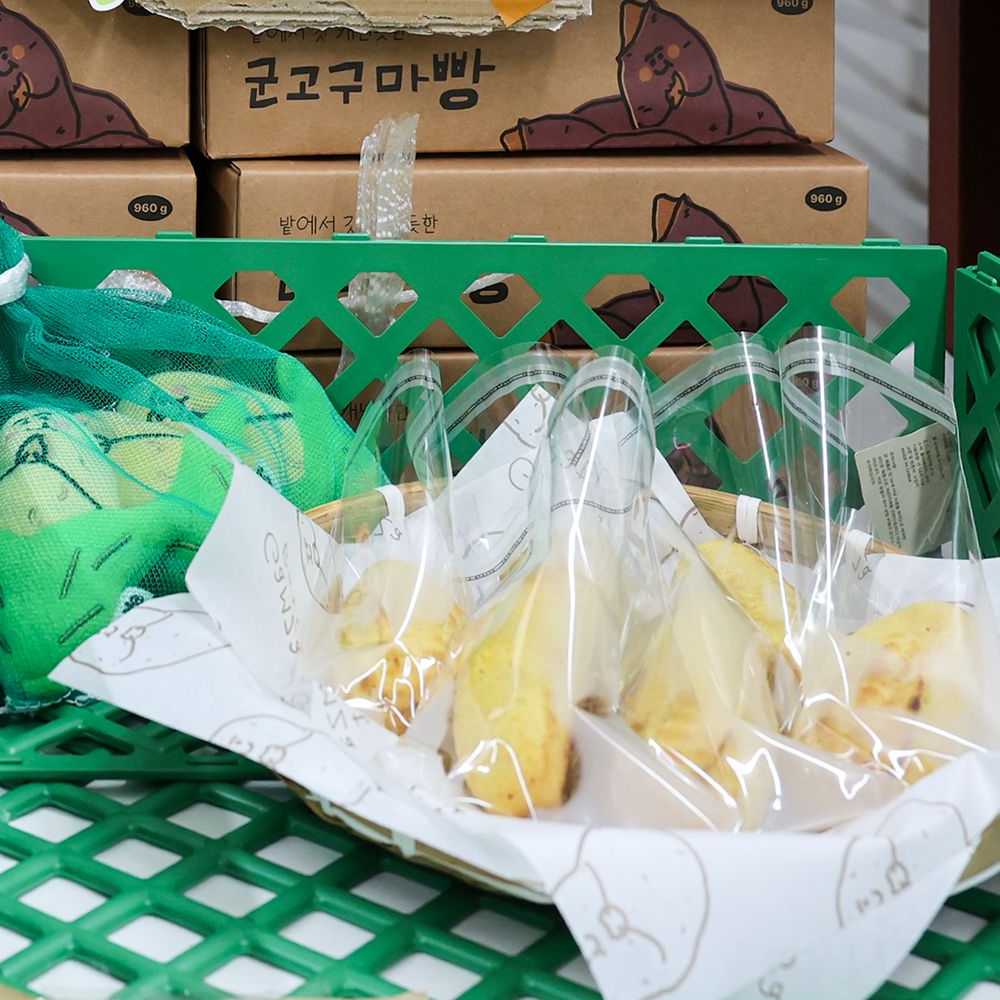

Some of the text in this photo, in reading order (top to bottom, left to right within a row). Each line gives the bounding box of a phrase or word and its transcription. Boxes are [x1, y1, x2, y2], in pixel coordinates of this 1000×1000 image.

[801, 0, 809, 10] g
[244, 48, 496, 111] 군고구마빵
[810, 193, 843, 206] 960 g
[133, 202, 168, 217] 960 g
[279, 215, 336, 236] 밭에서
